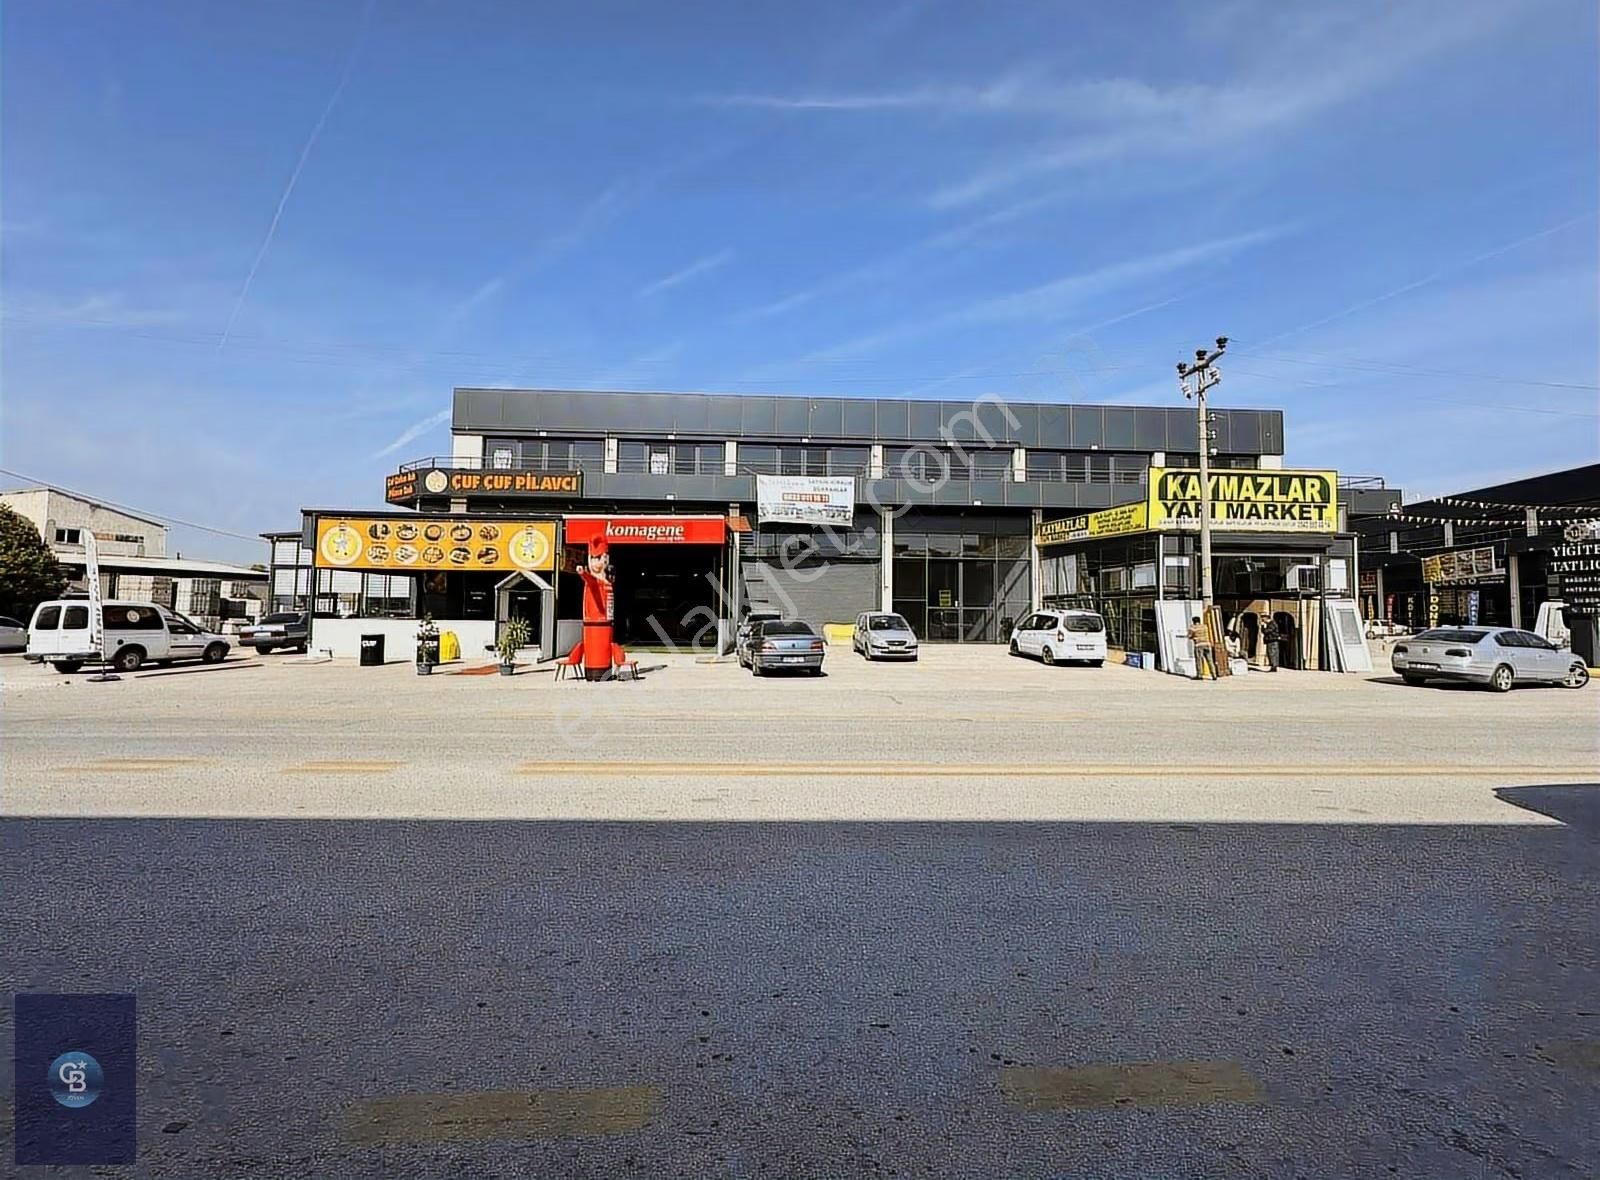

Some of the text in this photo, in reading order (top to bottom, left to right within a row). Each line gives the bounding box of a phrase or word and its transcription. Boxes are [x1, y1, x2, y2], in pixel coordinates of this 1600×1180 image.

[451, 472, 577, 492] ÇUF ÇUF PİLAVCI
[1166, 474, 1322, 502] KAYMAZLAR
[1226, 503, 1327, 520] MARKET
[605, 521, 684, 541] komagene
